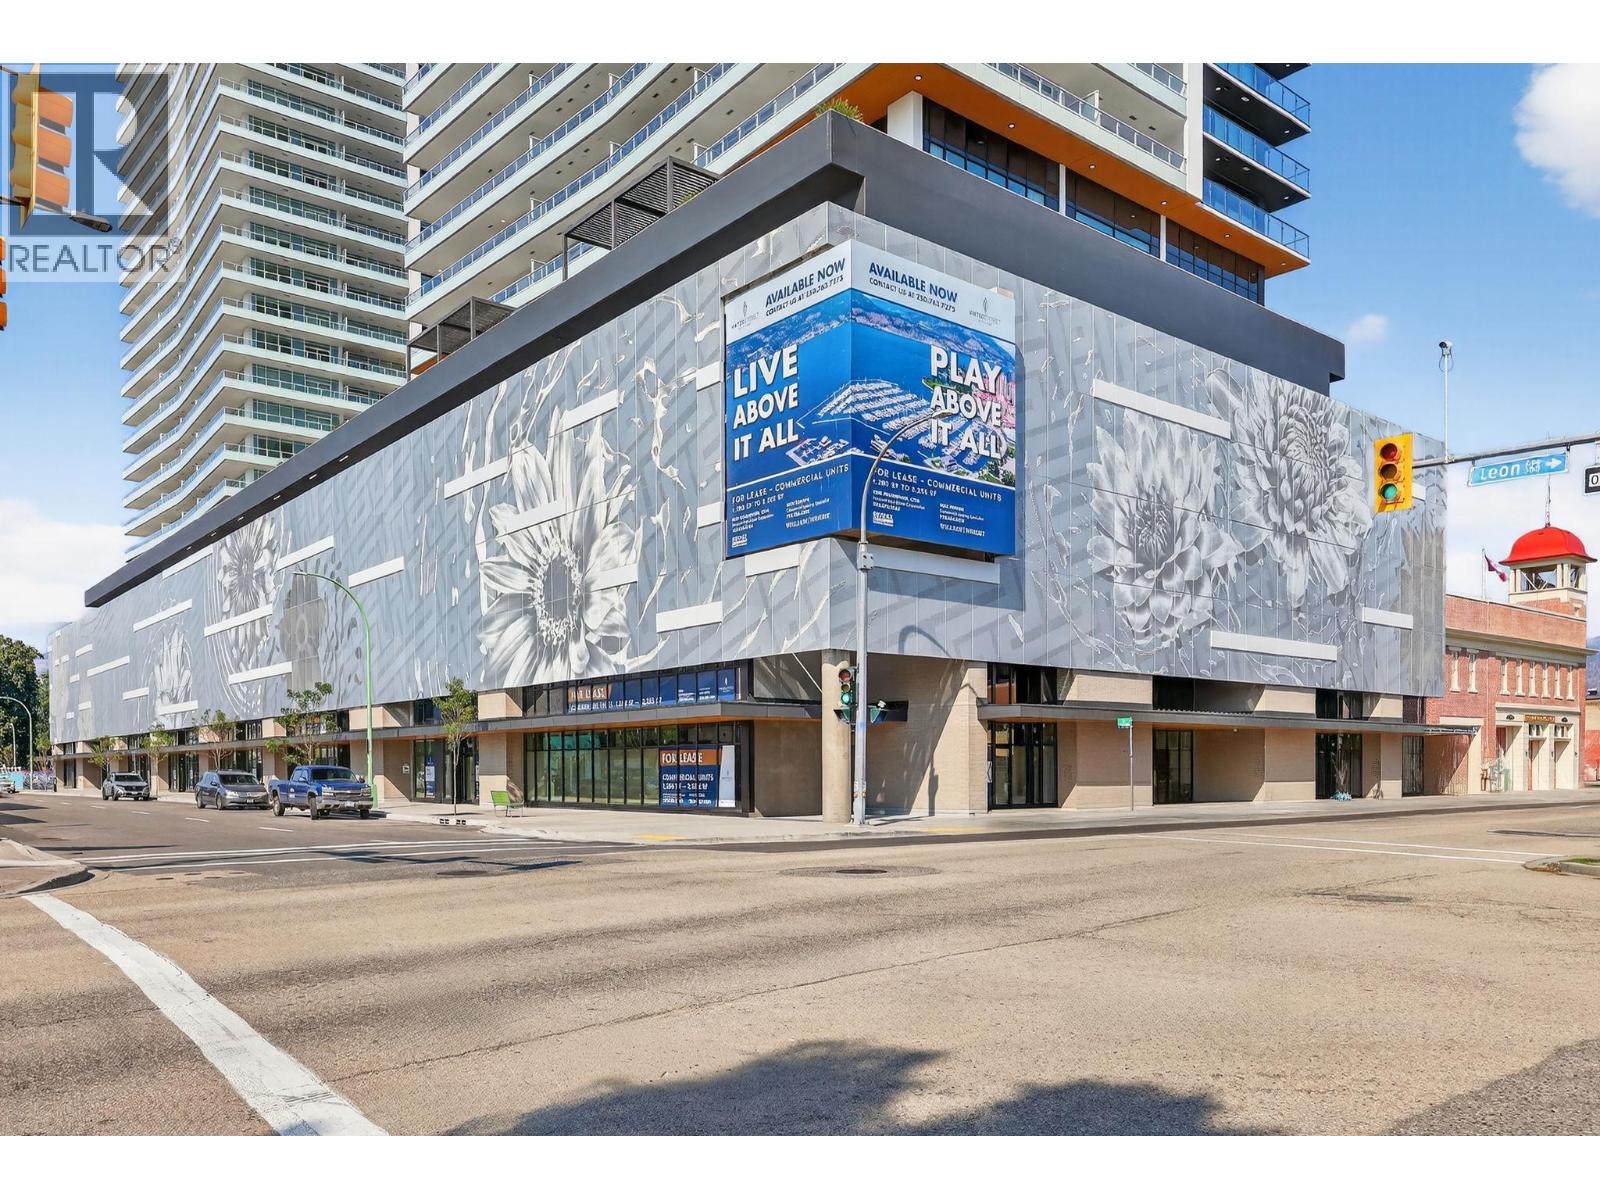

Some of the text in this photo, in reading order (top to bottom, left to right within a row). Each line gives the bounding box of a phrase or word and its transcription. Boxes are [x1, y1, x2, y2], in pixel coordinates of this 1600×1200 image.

[766, 258, 845, 307] AVAILABLE NOW
[869, 262, 958, 302] AVAILABLE NOW
[734, 344, 798, 399] LIVE
[931, 345, 1002, 394] PLAY
[733, 383, 798, 430] ABOVE
[930, 386, 1001, 427] ABOVE
[734, 418, 799, 461] IT ALL
[931, 419, 1005, 459] IT ALL
[732, 494, 744, 504] FOR
[747, 488, 767, 501] LEASE
[775, 474, 823, 492] COMMERCIAL
[826, 464, 849, 477] UNITS
[892, 471, 917, 483] LEASE
[927, 479, 977, 496] COMMERCIAL
[980, 491, 1002, 502] UNITS
[1480, 465, 1520, 480] Leon
[662, 753, 677, 763] FOR
